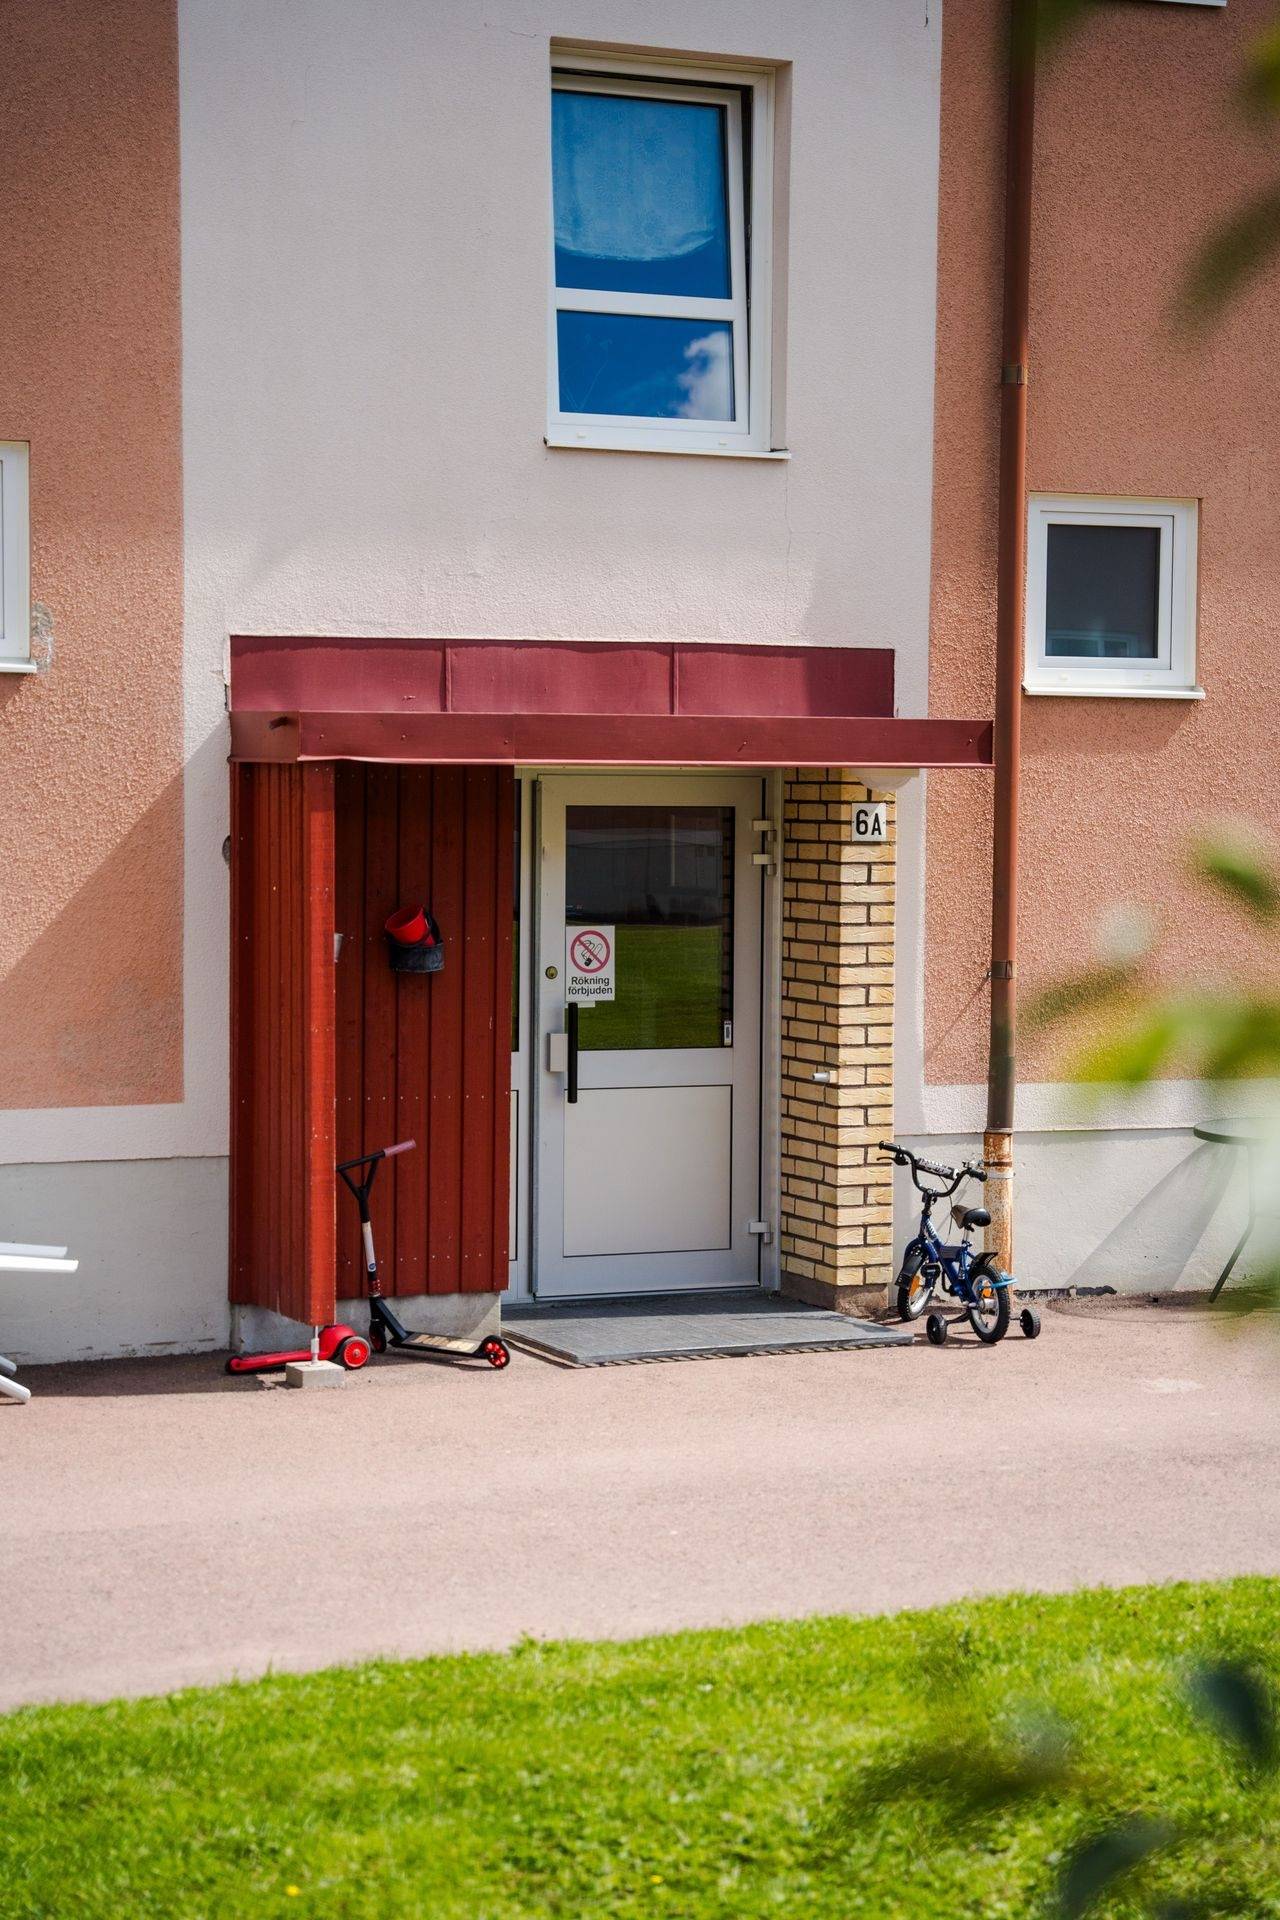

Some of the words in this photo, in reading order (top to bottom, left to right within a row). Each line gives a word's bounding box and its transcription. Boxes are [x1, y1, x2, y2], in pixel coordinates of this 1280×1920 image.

[856, 809, 882, 835] 6A
[571, 976, 610, 986] Rökning
[568, 986, 613, 996] förbjuden
